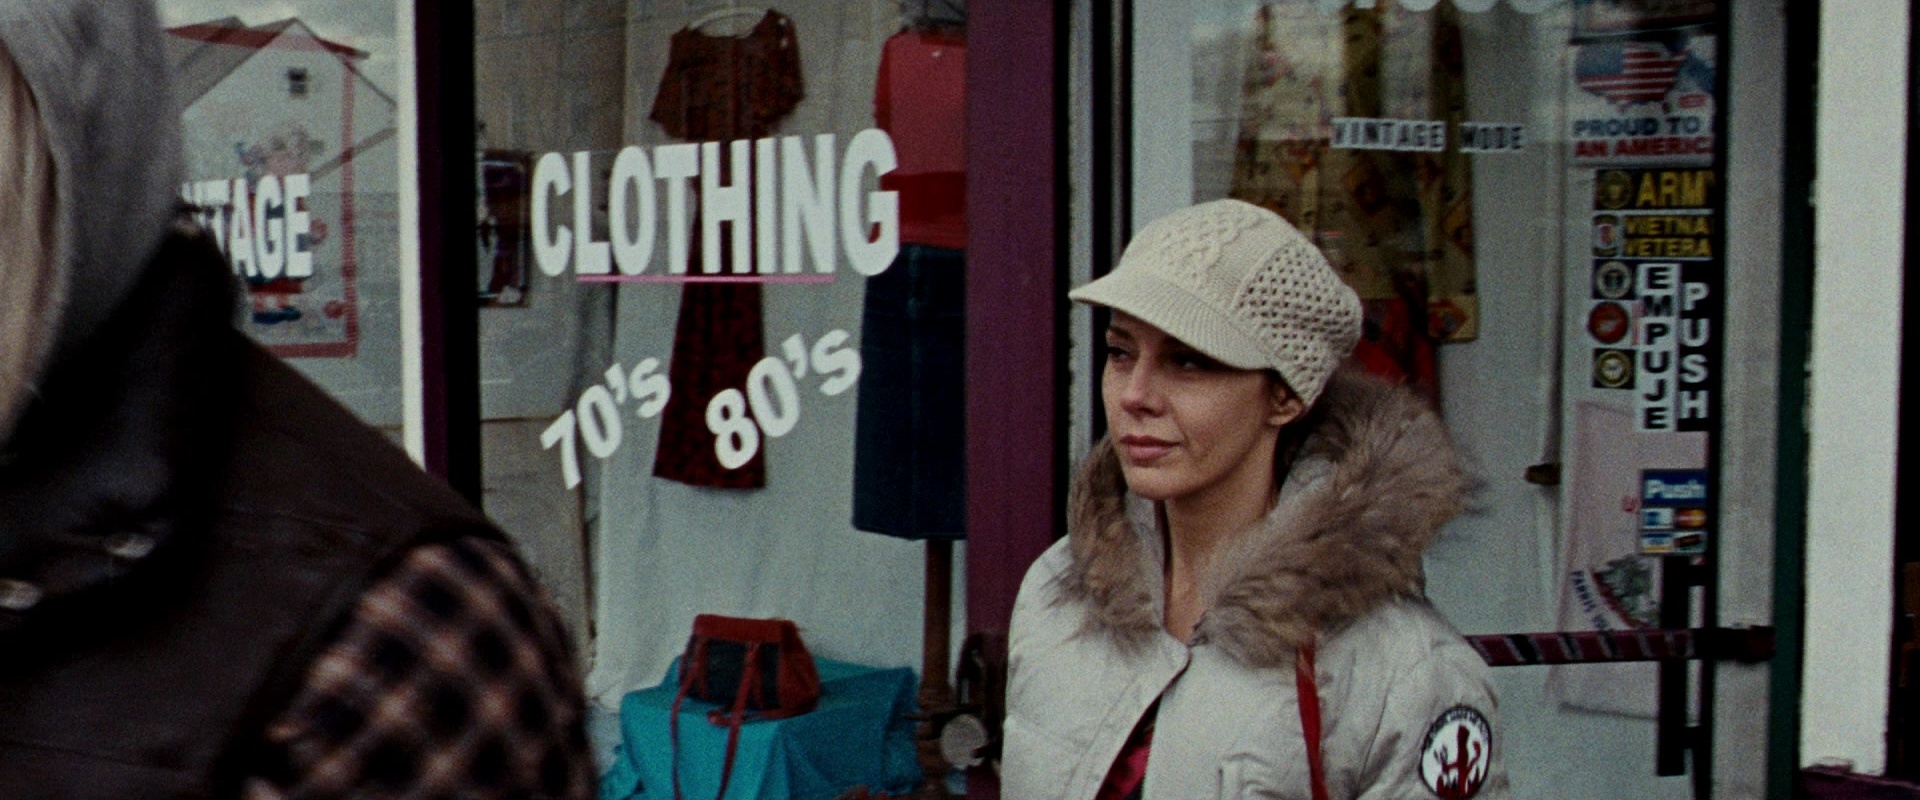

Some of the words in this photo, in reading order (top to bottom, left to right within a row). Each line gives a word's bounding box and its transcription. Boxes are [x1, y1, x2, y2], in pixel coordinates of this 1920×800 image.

[1334, 121, 1442, 147] VINTAGE
[1574, 117, 1658, 137] PROUD
[1666, 116, 1700, 134] TO
[1575, 140, 1608, 157] AN
[531, 128, 899, 276] CLOTHING
[182, 173, 313, 278] TAGE
[1625, 216, 1713, 236] VIETNA
[1625, 238, 1712, 257] VETERA
[1643, 266, 1673, 430] EMPUJE
[1680, 281, 1710, 419] PUSH
[1645, 479, 1706, 499] Push
